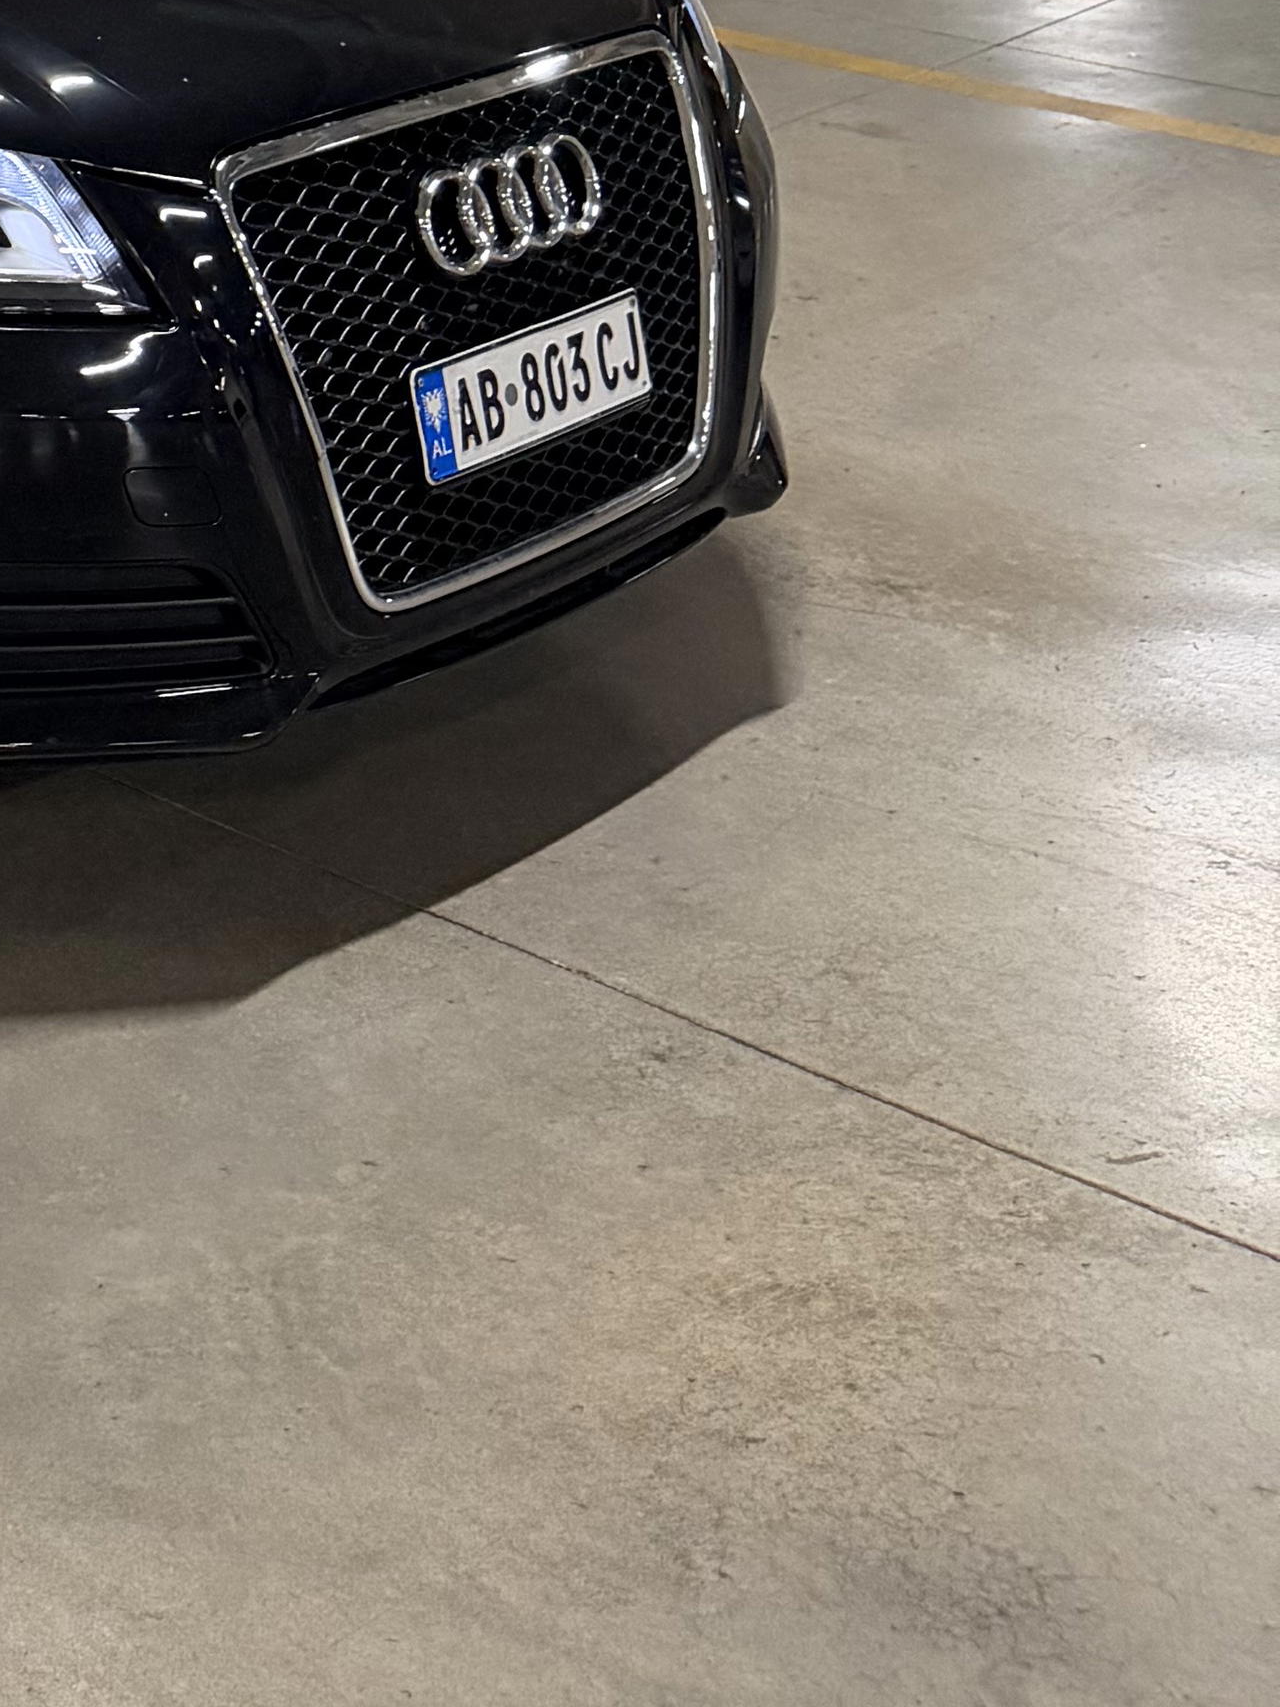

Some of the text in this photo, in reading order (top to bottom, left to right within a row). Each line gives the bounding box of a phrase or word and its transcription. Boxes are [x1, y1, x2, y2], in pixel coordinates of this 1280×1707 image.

[457, 311, 640, 452] AB 803 CJ
[432, 437, 453, 460] AL
